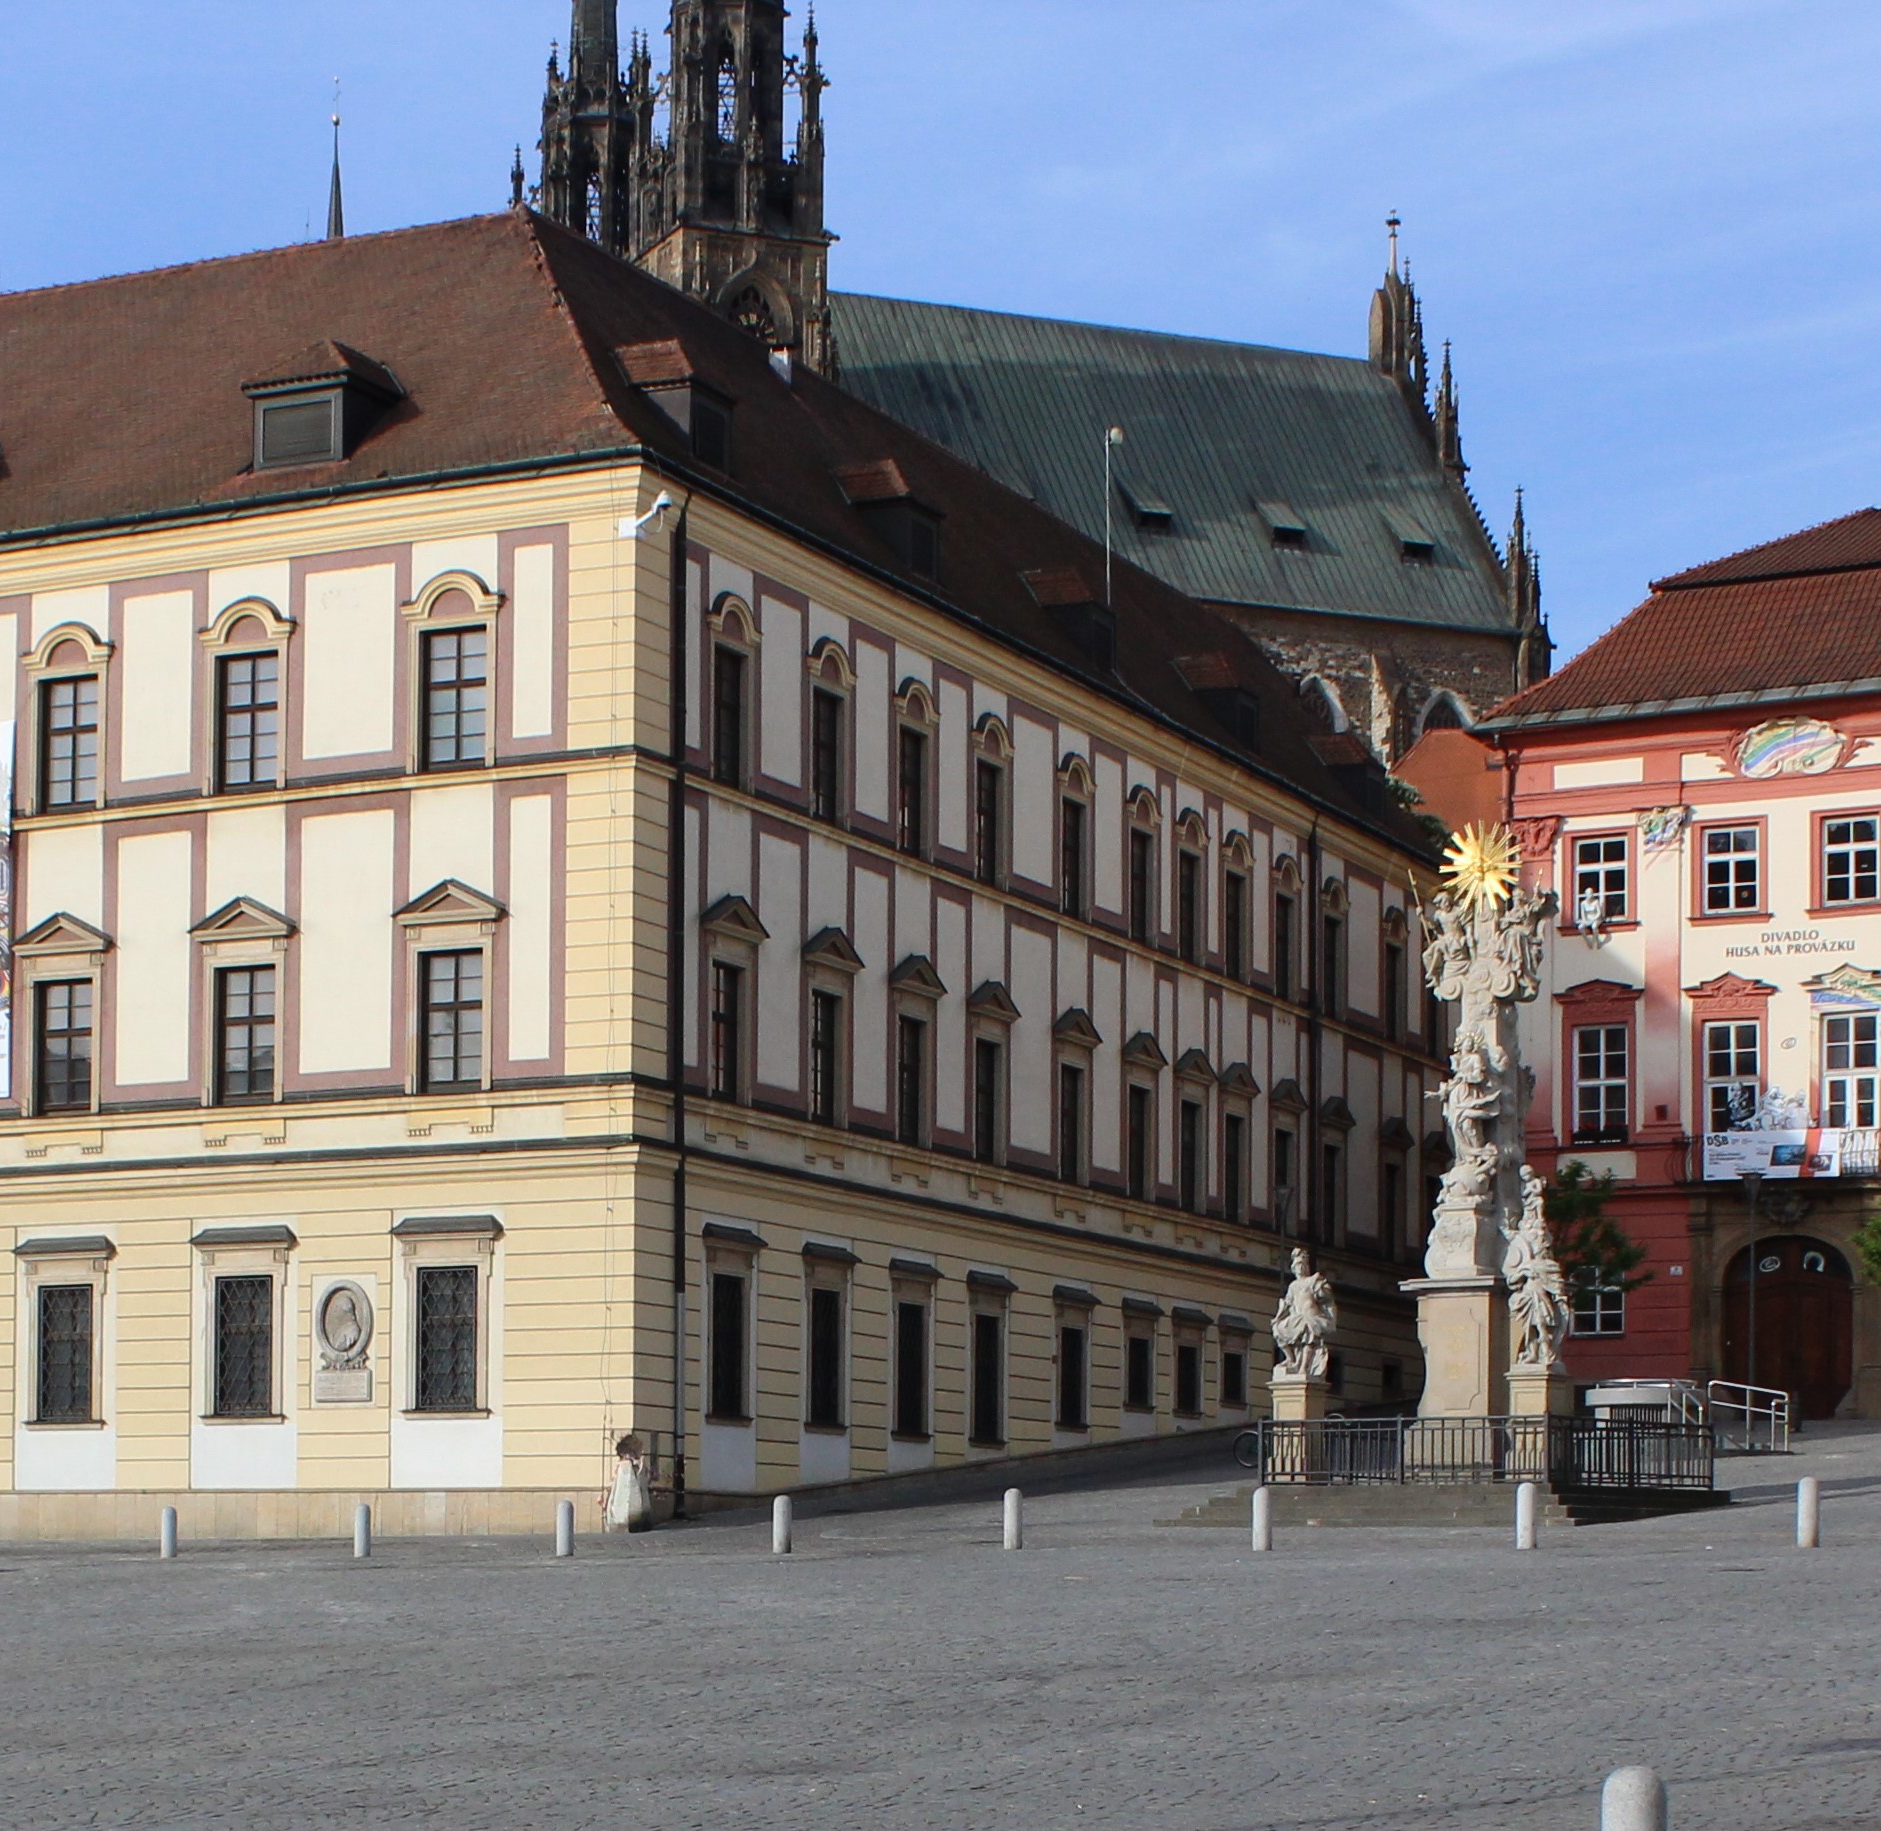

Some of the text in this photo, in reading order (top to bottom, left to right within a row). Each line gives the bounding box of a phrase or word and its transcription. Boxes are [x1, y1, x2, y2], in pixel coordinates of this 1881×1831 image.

[1761, 930, 1820, 944] DIVADLO
[1725, 939, 1856, 958] HUSA NA PROVÁZKU
